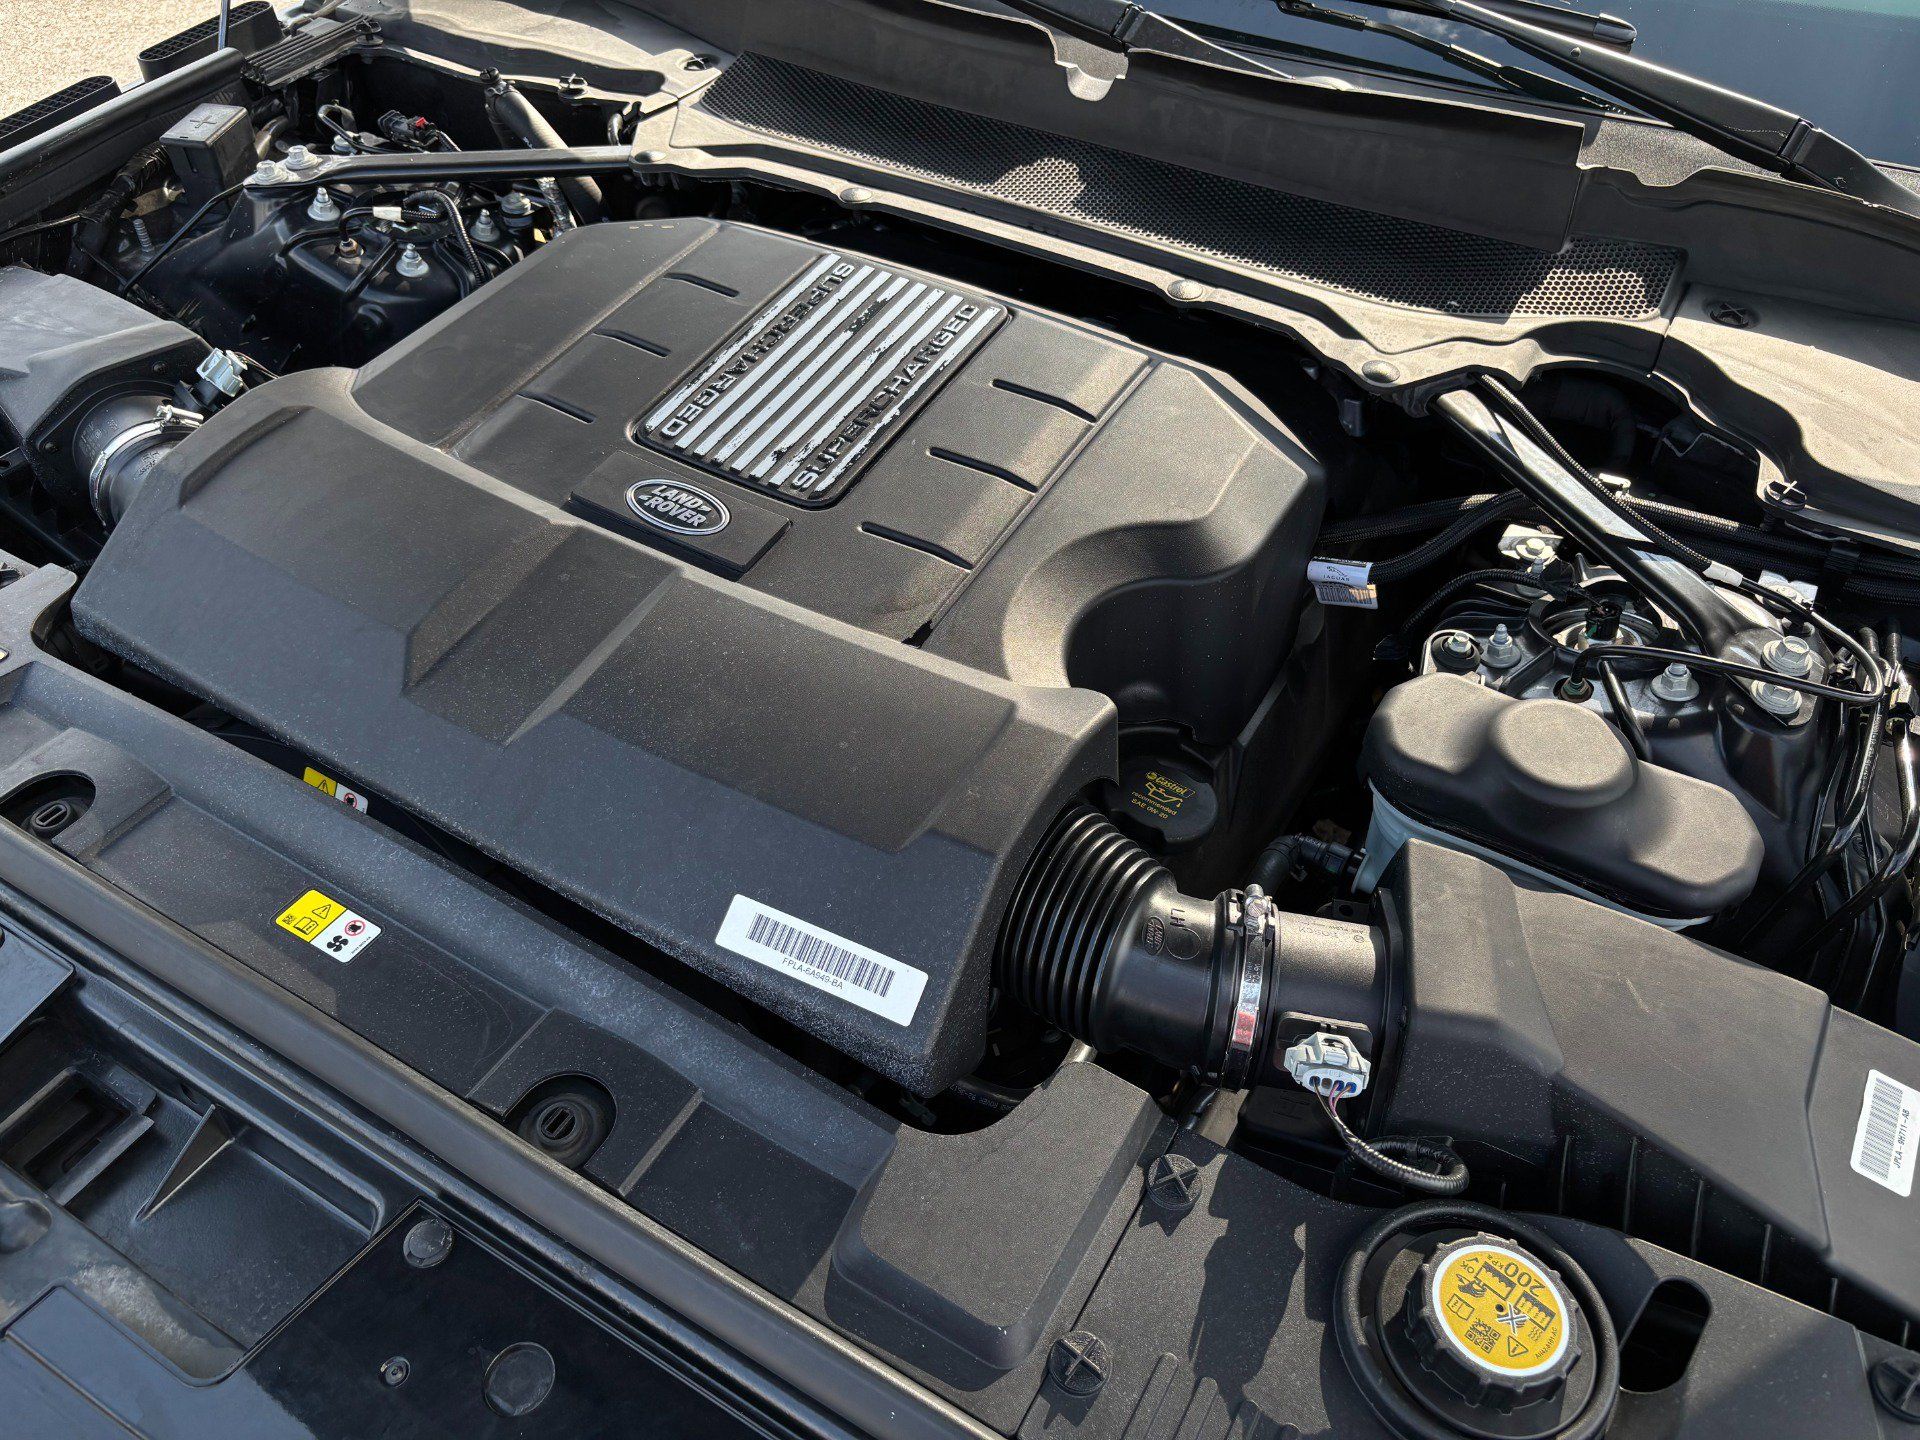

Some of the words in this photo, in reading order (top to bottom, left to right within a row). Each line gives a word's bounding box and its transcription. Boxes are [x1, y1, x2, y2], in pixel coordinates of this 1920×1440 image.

[660, 262, 855, 439] SUPERCHARGED
[792, 304, 980, 490] SUPERCHARGED
[651, 485, 703, 509] LAND
[644, 496, 707, 527] ROVER
[1323, 574, 1350, 582] JAGUAR
[1155, 777, 1188, 795] Castrol
[1131, 791, 1178, 816] recommended
[1131, 798, 1146, 809] SAE
[1169, 907, 1186, 928] LH
[782, 956, 844, 991] FPLA-6A949-BA
[1459, 1261, 1475, 1275] OK
[1504, 1262, 1546, 1297] 200
